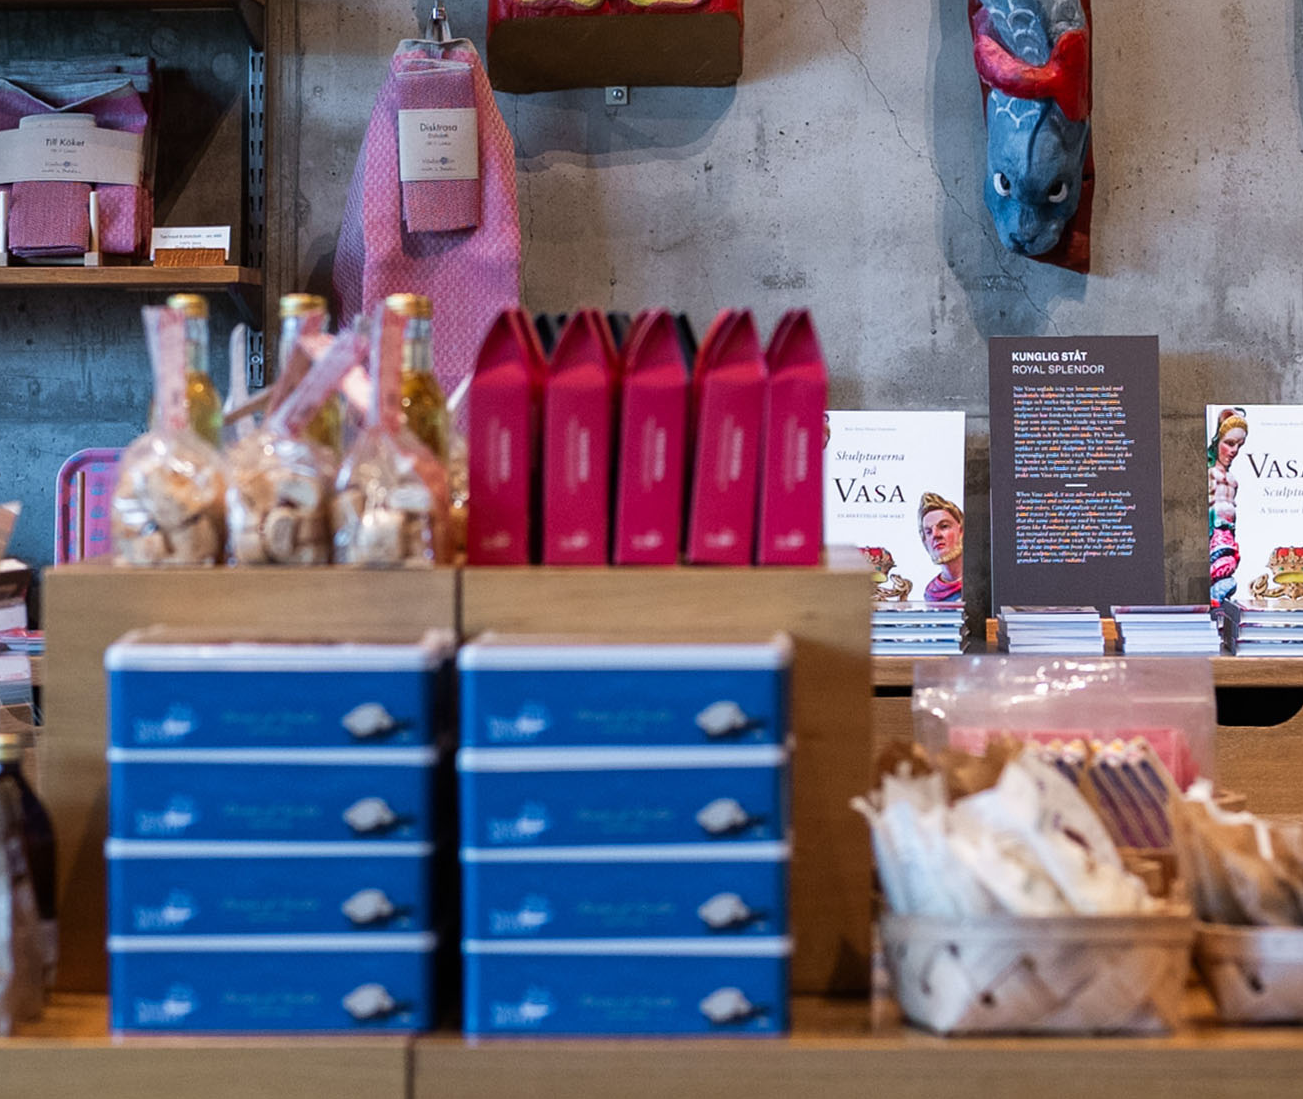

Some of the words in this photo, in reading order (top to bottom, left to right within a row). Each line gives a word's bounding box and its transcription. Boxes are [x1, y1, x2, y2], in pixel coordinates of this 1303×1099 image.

[45, 138, 58, 147] Till
[59, 138, 85, 147] Köket
[1011, 351, 1060, 362] KUNGLIG
[1060, 348, 1088, 362] STÅT
[1012, 364, 1046, 375] ROYAL
[1047, 364, 1105, 375] SPLENDOR
[835, 450, 906, 464] Skulpturerna
[863, 465, 877, 478] på
